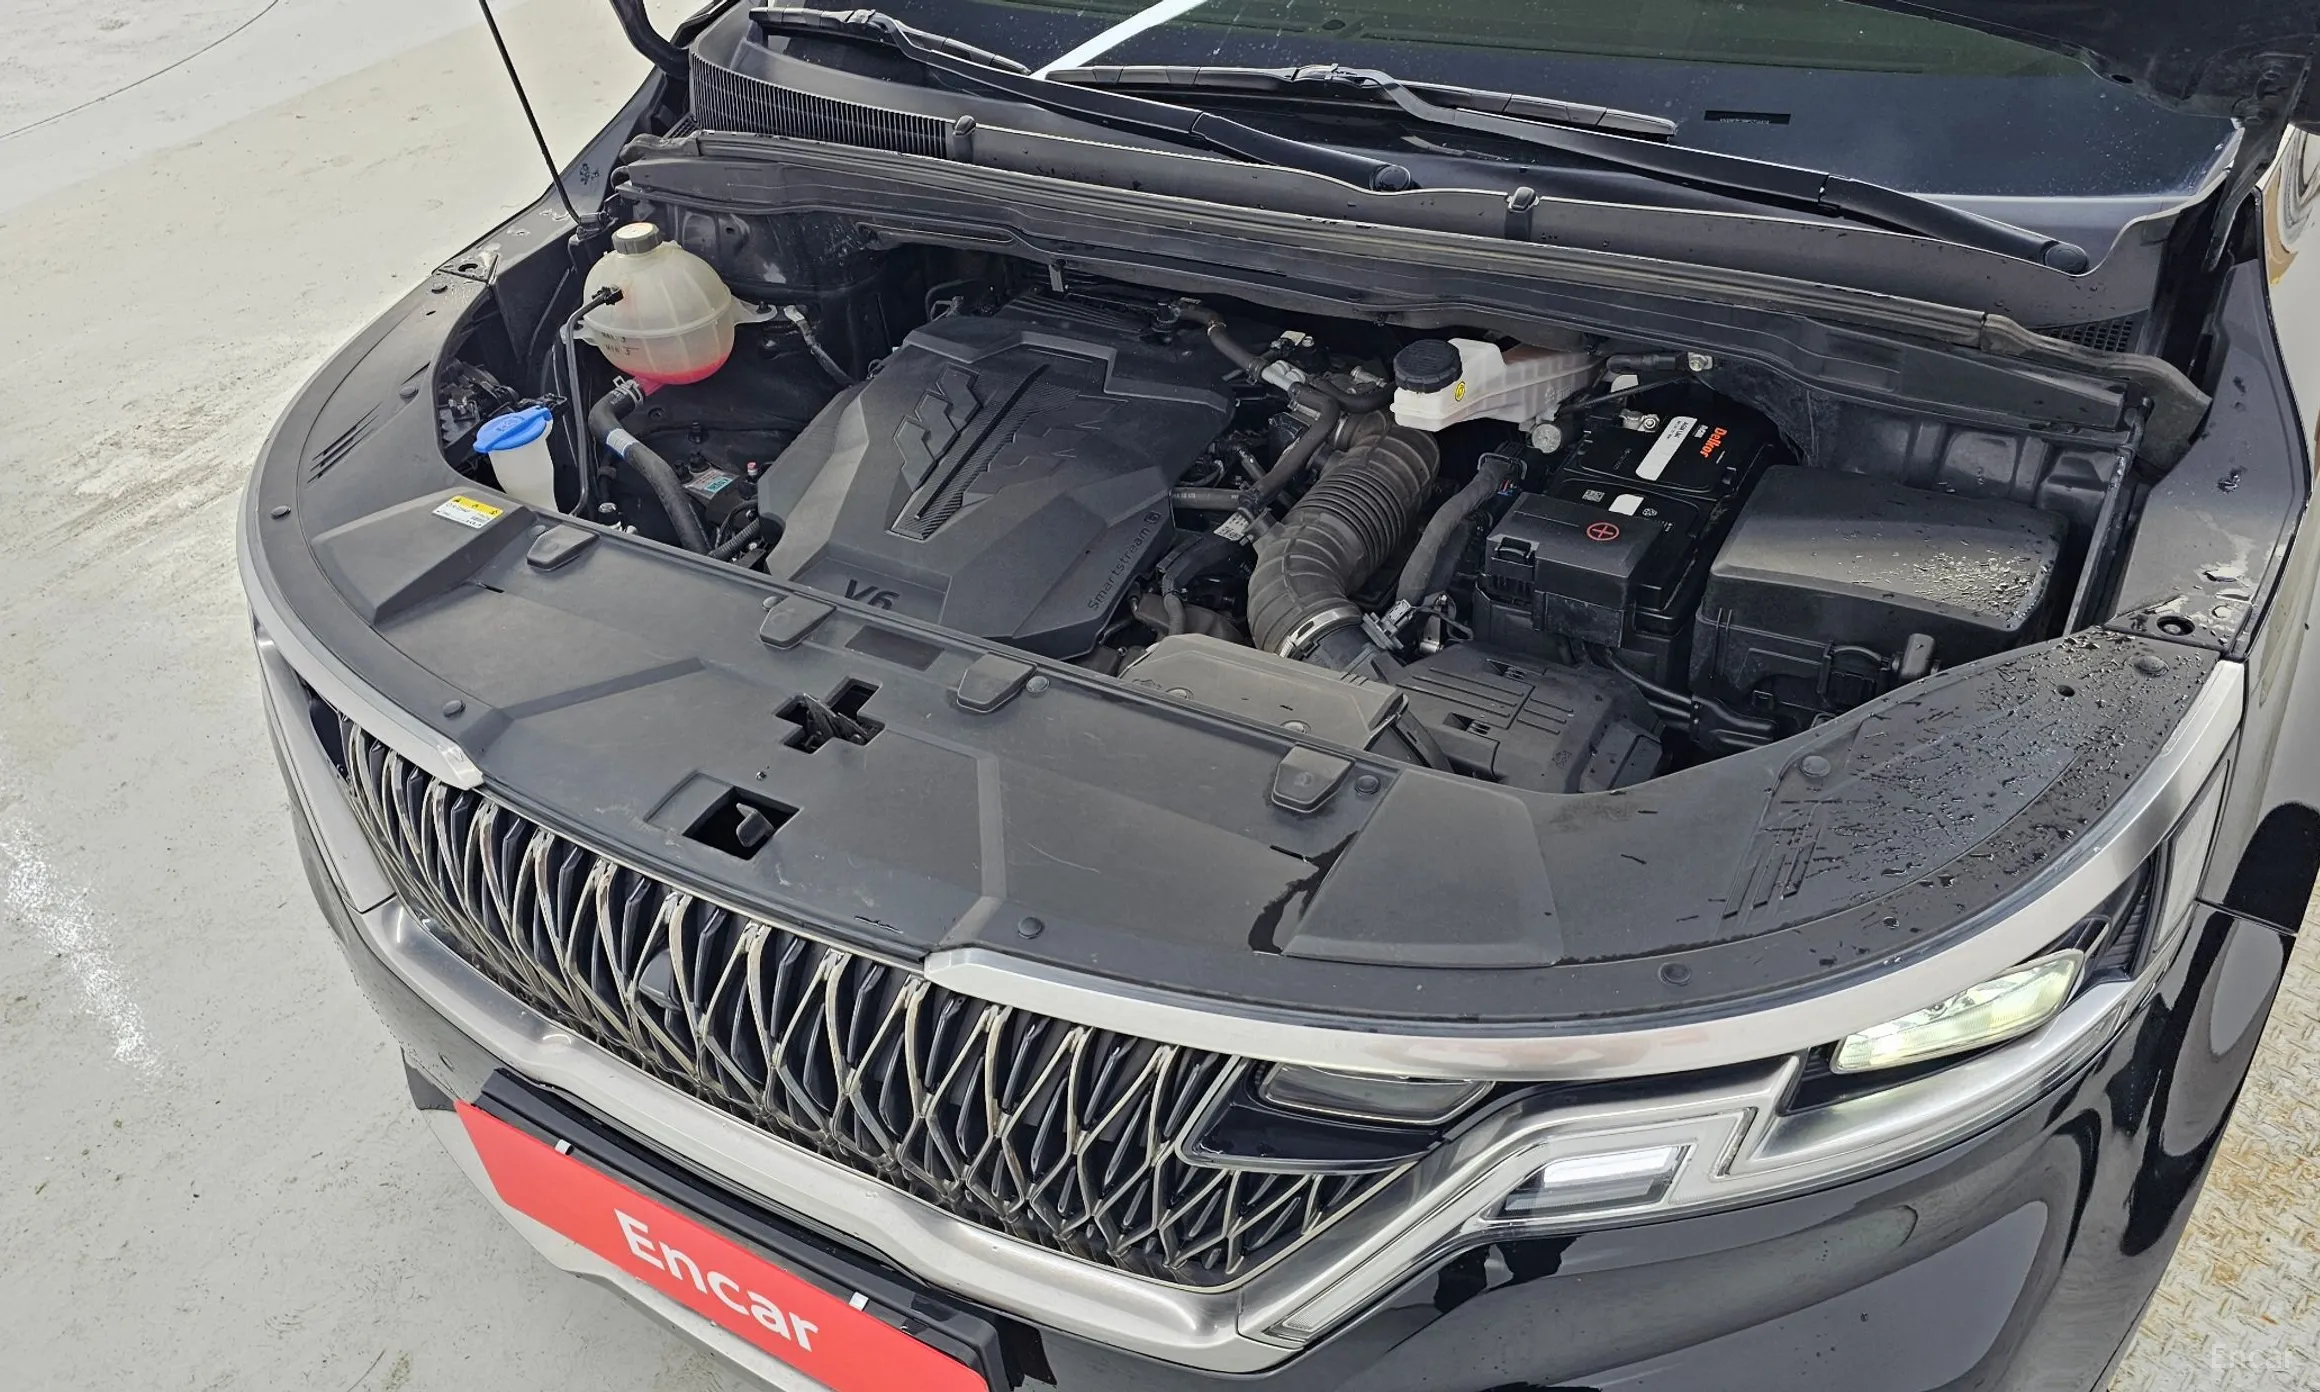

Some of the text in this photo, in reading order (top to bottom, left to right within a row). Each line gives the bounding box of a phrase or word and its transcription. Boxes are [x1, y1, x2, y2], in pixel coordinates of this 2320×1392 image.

[1699, 427, 1728, 458] Delkor
[843, 579, 900, 611] V6
[1087, 526, 1151, 611] Smartstream
[613, 1207, 819, 1353] Encar
